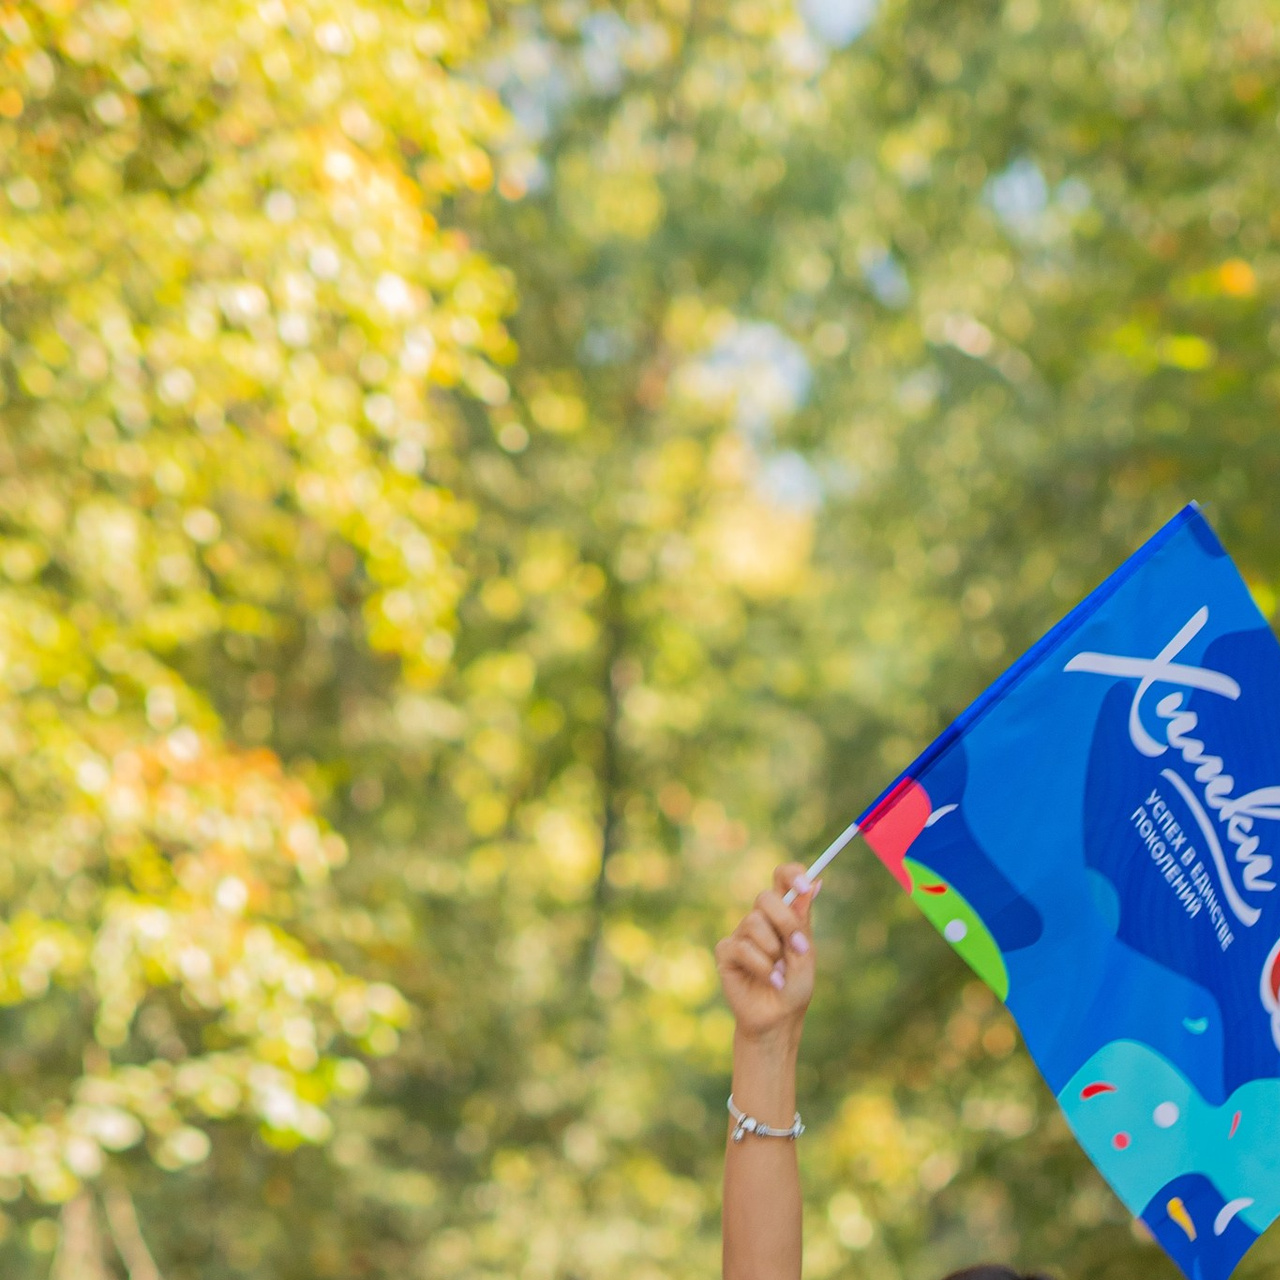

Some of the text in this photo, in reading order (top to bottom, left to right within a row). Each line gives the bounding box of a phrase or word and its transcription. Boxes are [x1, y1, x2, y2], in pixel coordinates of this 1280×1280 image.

[1130, 806, 1203, 919] ПОКОЛЕНИЙ
[1145, 788, 1235, 952] УСПЕХ В ЕДИНСТВЕ
